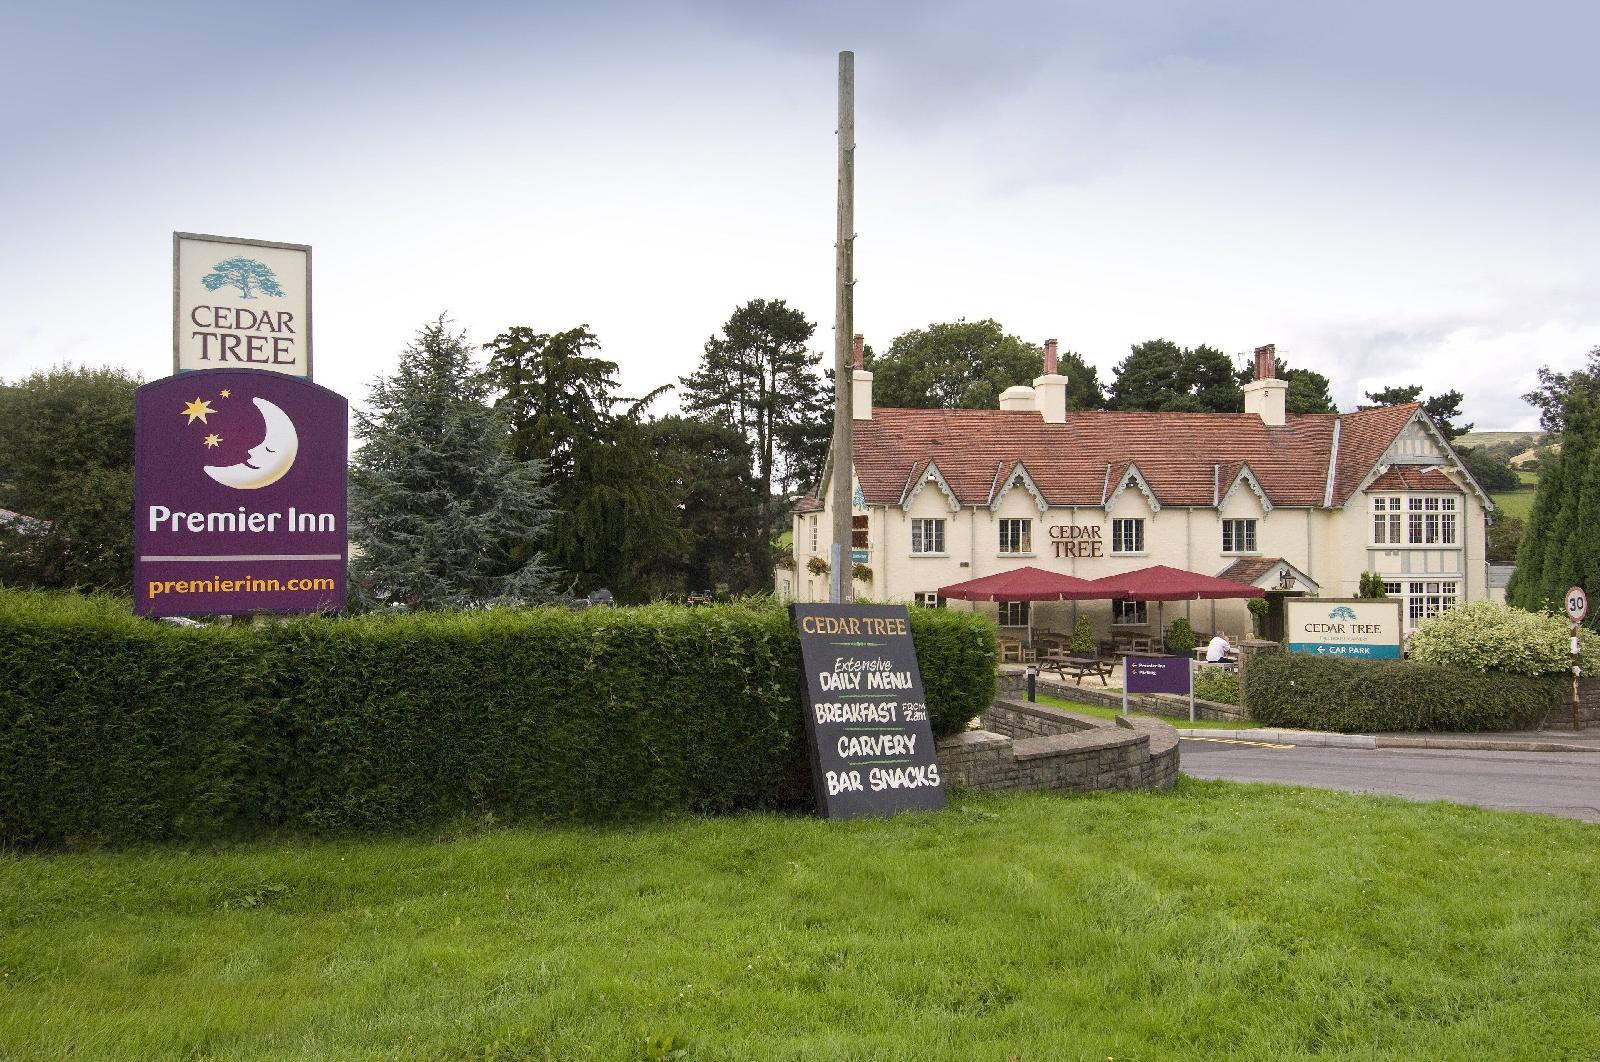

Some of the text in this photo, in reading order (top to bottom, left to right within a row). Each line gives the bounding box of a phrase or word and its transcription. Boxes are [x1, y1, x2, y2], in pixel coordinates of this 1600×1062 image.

[191, 305, 295, 334] CEDAR
[192, 332, 296, 365] TREE
[149, 505, 335, 533] Premier Inn
[1049, 525, 1102, 539] CEDAR
[1051, 540, 1104, 558] TREE
[148, 575, 335, 598] premierinn.com
[1569, 597, 1584, 611] 30
[802, 616, 907, 635] CEDAR TREE
[1304, 623, 1381, 634] CEDAR TREE
[834, 657, 892, 672] Extensive
[819, 671, 913, 692] DAILY MENU
[815, 701, 898, 724] BREAKFAST
[902, 702, 926, 710] FROM
[837, 733, 917, 758] CARVERY
[825, 763, 941, 796] BAR SNACKS
